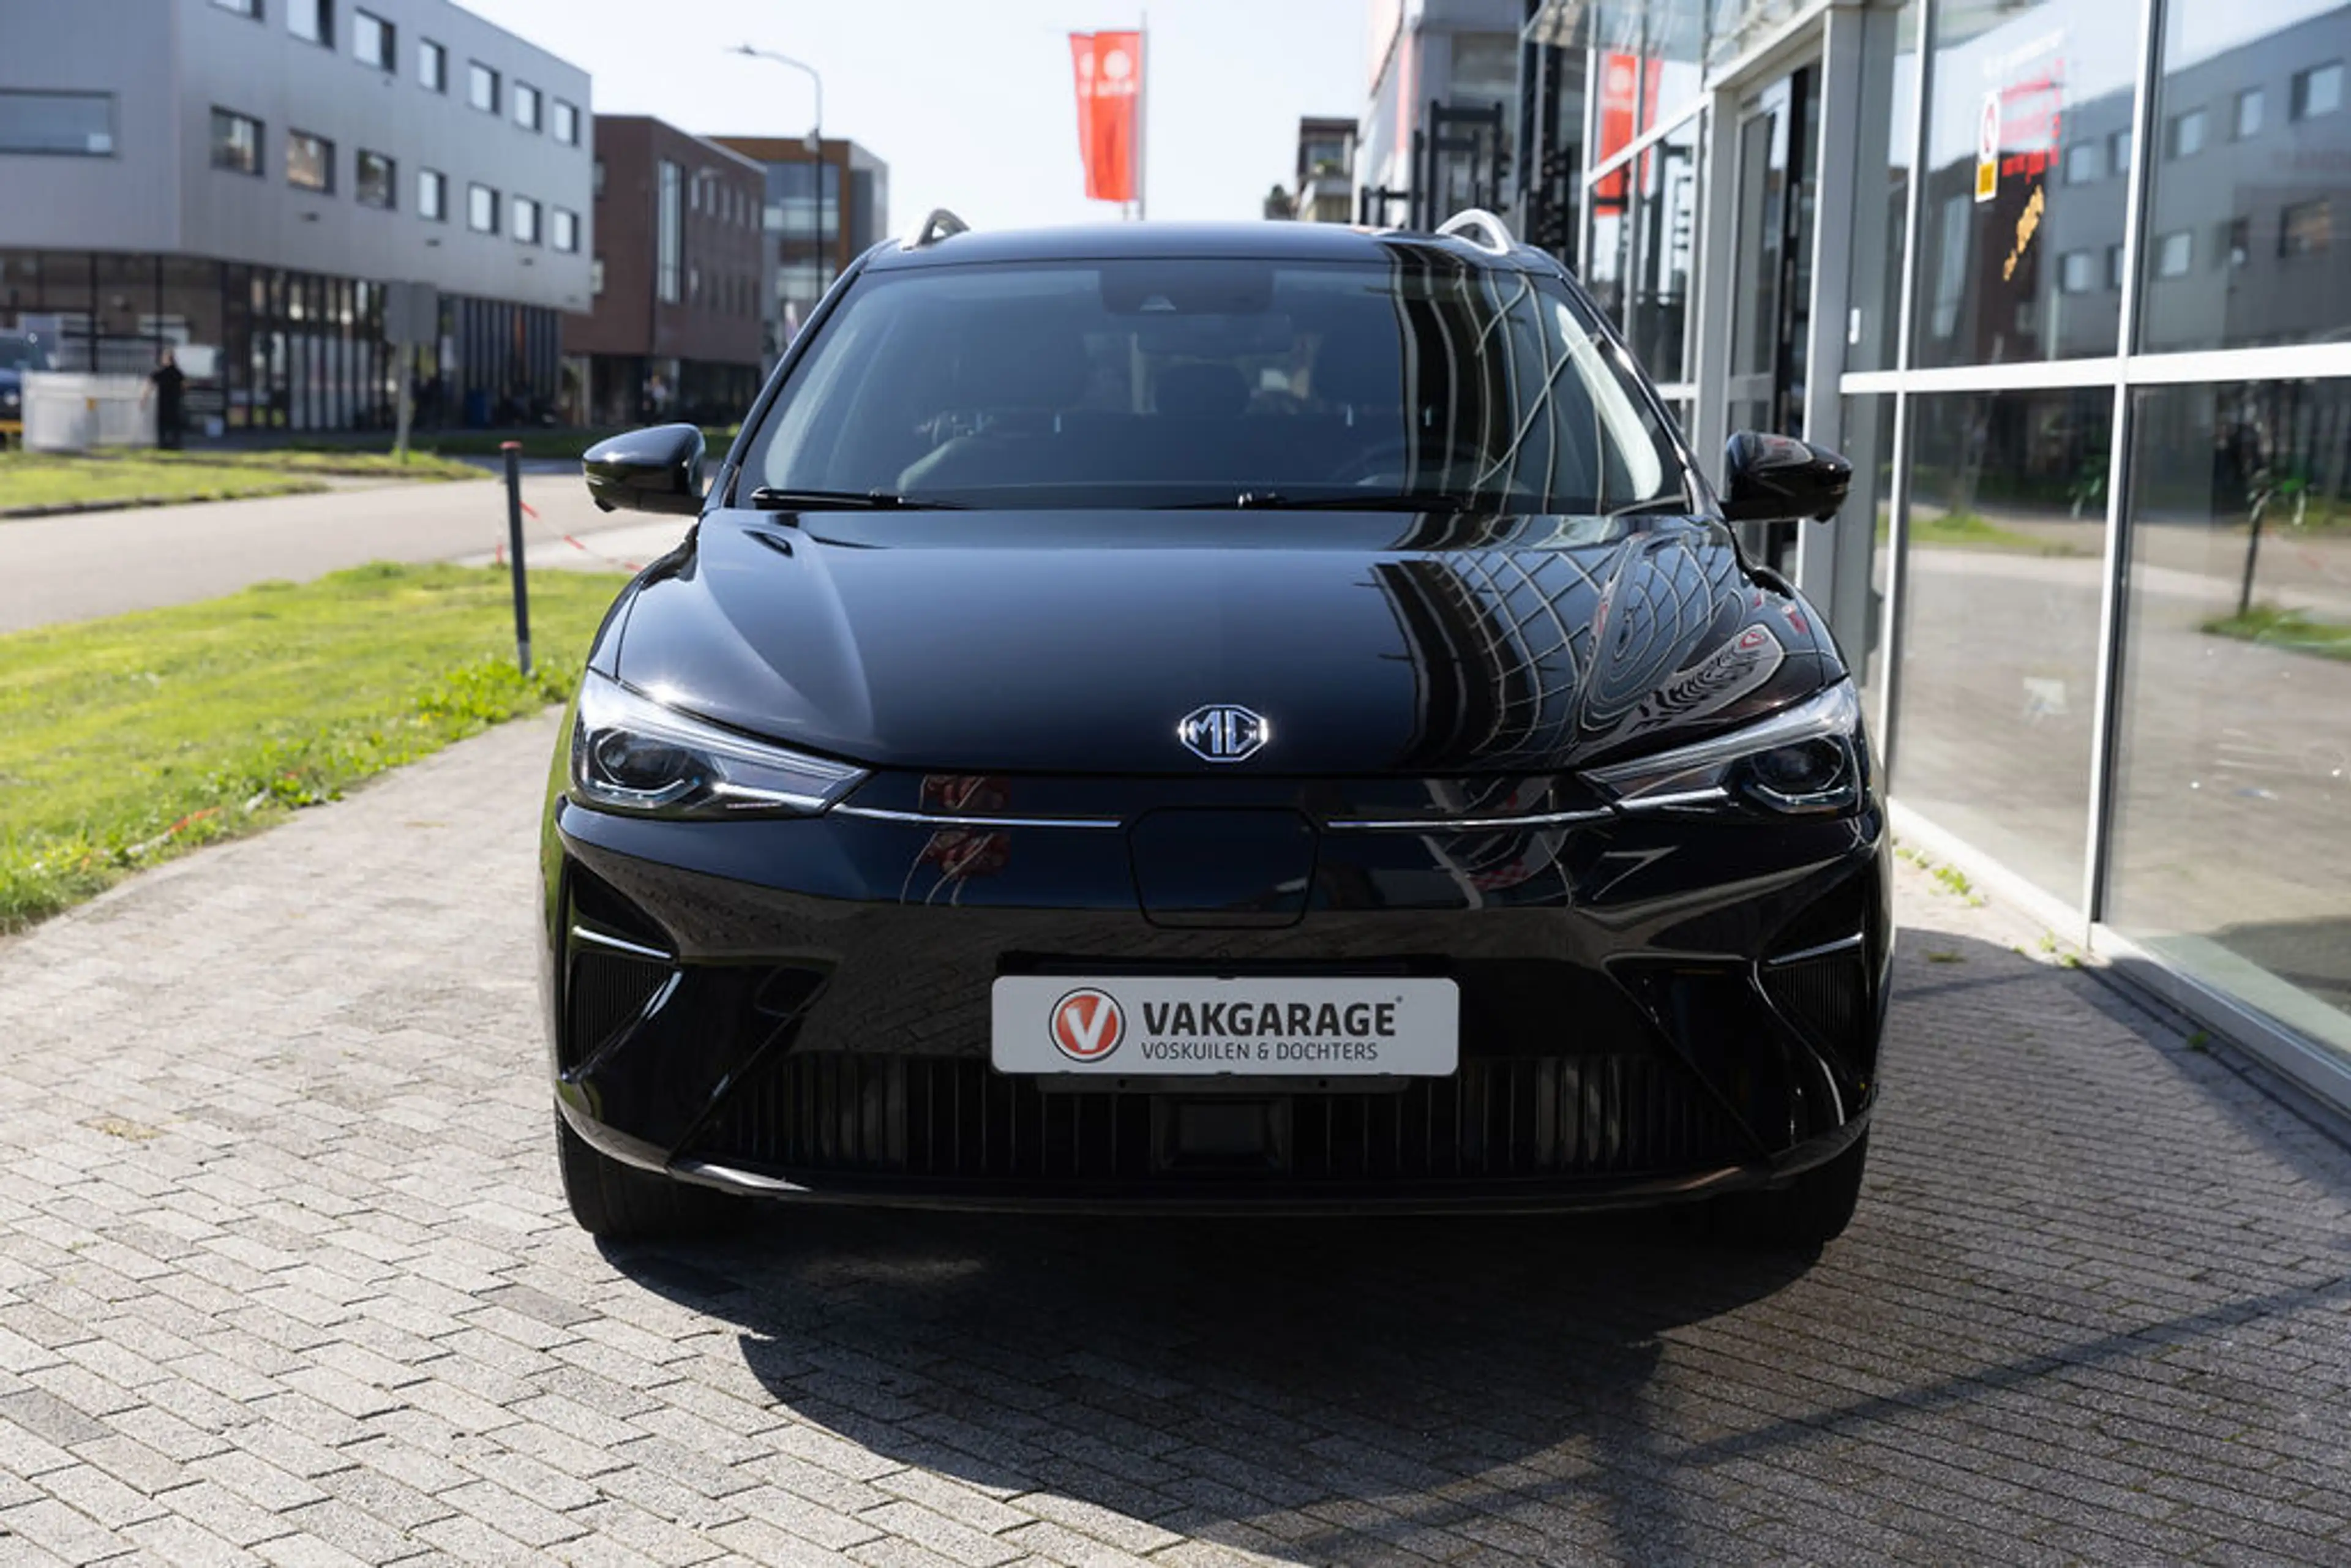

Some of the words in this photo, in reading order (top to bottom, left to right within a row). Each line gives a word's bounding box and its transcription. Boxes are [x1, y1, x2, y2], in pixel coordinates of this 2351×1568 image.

[1187, 709, 1258, 755] MG
[1142, 1002, 1397, 1037] VAKGARAGE
[1141, 1042, 1250, 1060] VOSKUILEN
[1257, 1042, 1269, 1060] &
[1277, 1042, 1379, 1060] DOCHTERS
